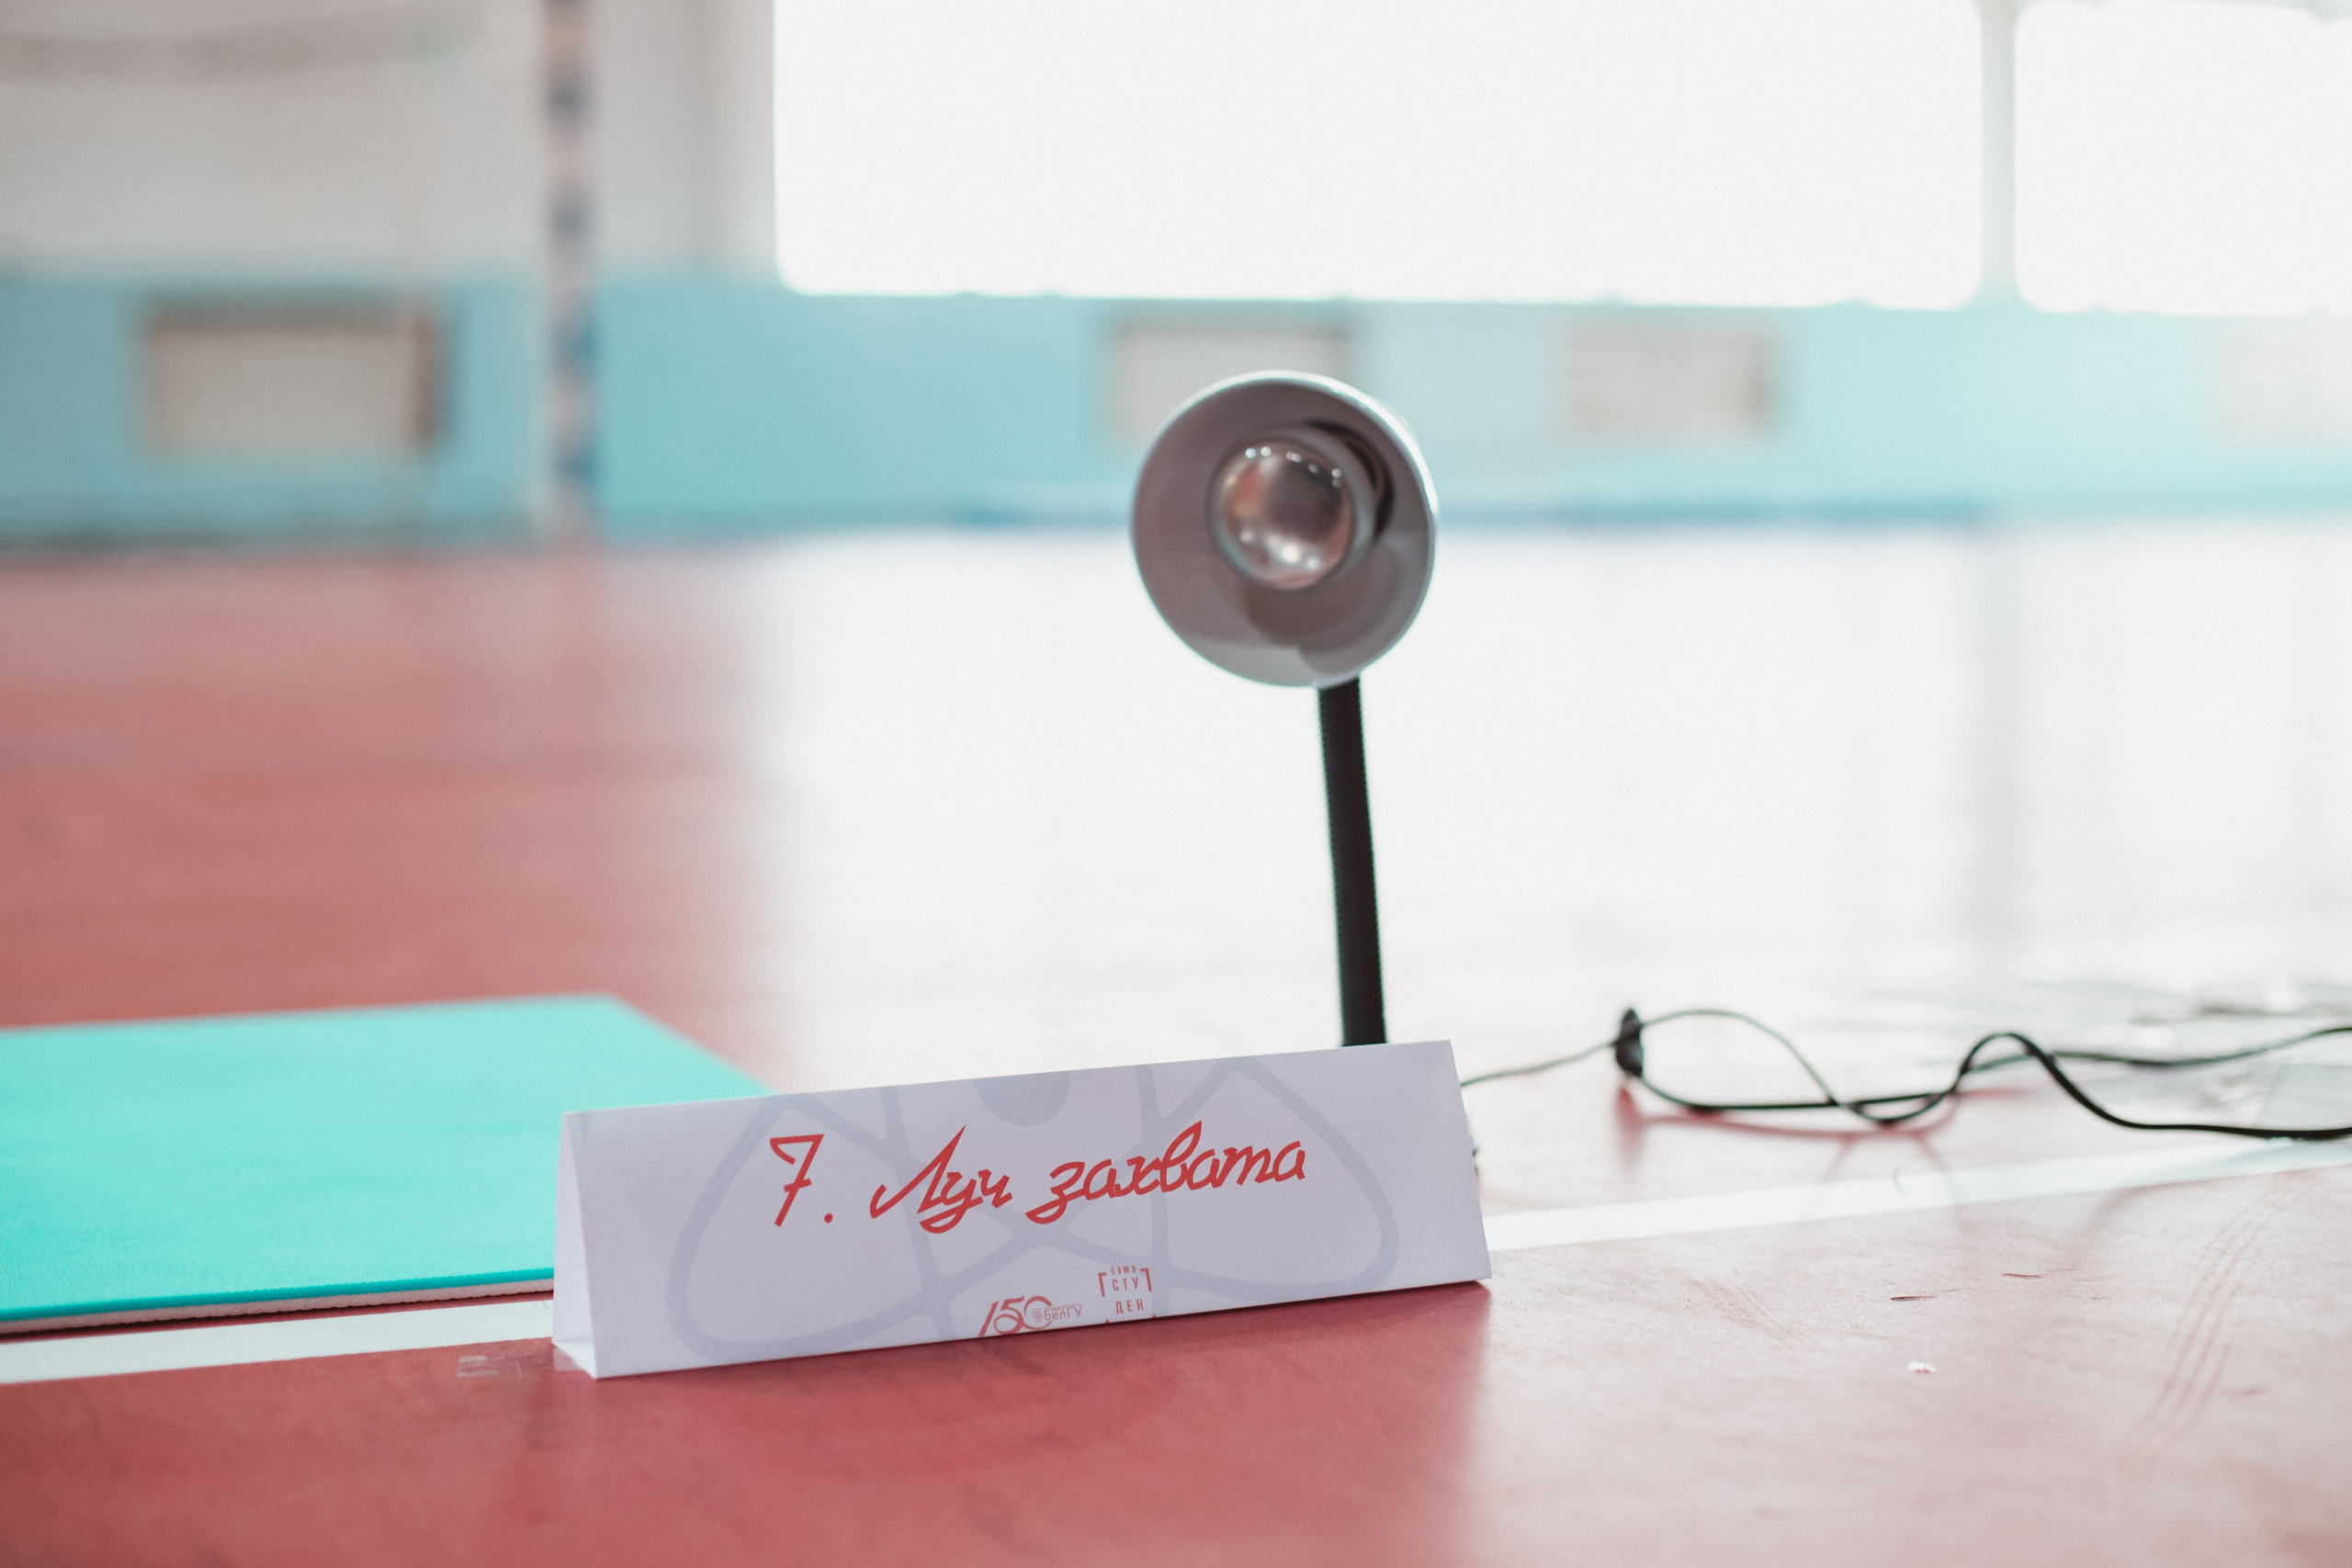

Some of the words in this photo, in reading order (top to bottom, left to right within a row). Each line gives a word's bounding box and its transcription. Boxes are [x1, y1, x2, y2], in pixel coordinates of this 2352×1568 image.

[769, 1134, 833, 1227] 7.
[869, 1123, 1013, 1235] Луч
[1024, 1120, 1306, 1225] захвата
[1110, 1265, 1136, 1276] СОЮЗ
[1112, 1276, 1139, 1292] СТУ
[1044, 1305, 1082, 1321] БелГУ
[1114, 1298, 1144, 1314] ДЕН
[978, 1294, 1053, 1336] 150
